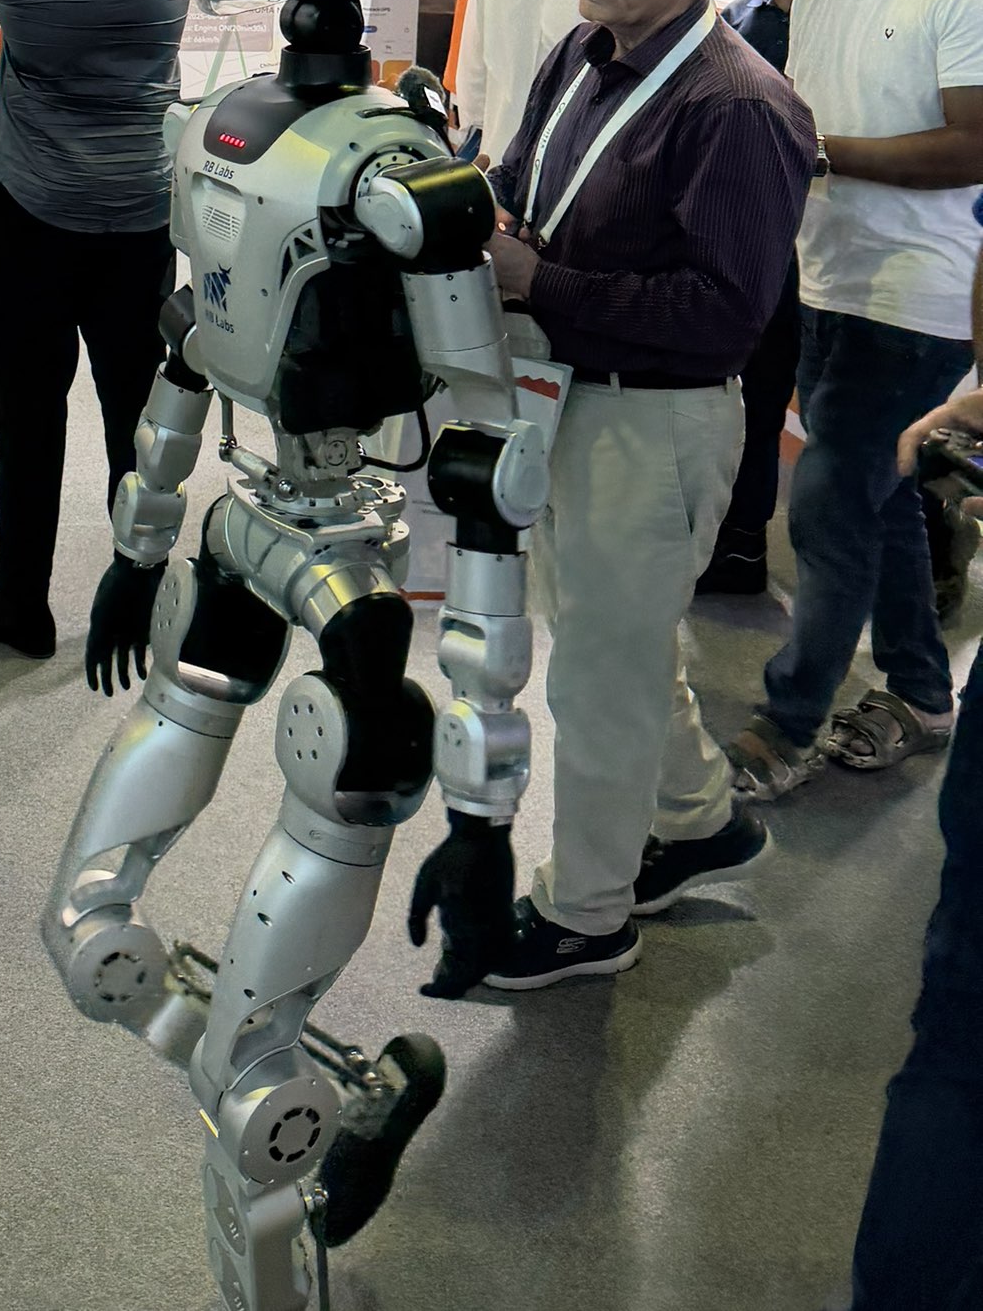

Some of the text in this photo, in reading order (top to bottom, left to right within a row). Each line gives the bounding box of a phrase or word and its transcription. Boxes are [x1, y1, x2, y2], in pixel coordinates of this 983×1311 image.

[203, 160, 234, 180] RB Labs
[215, 316, 234, 334] Labs
